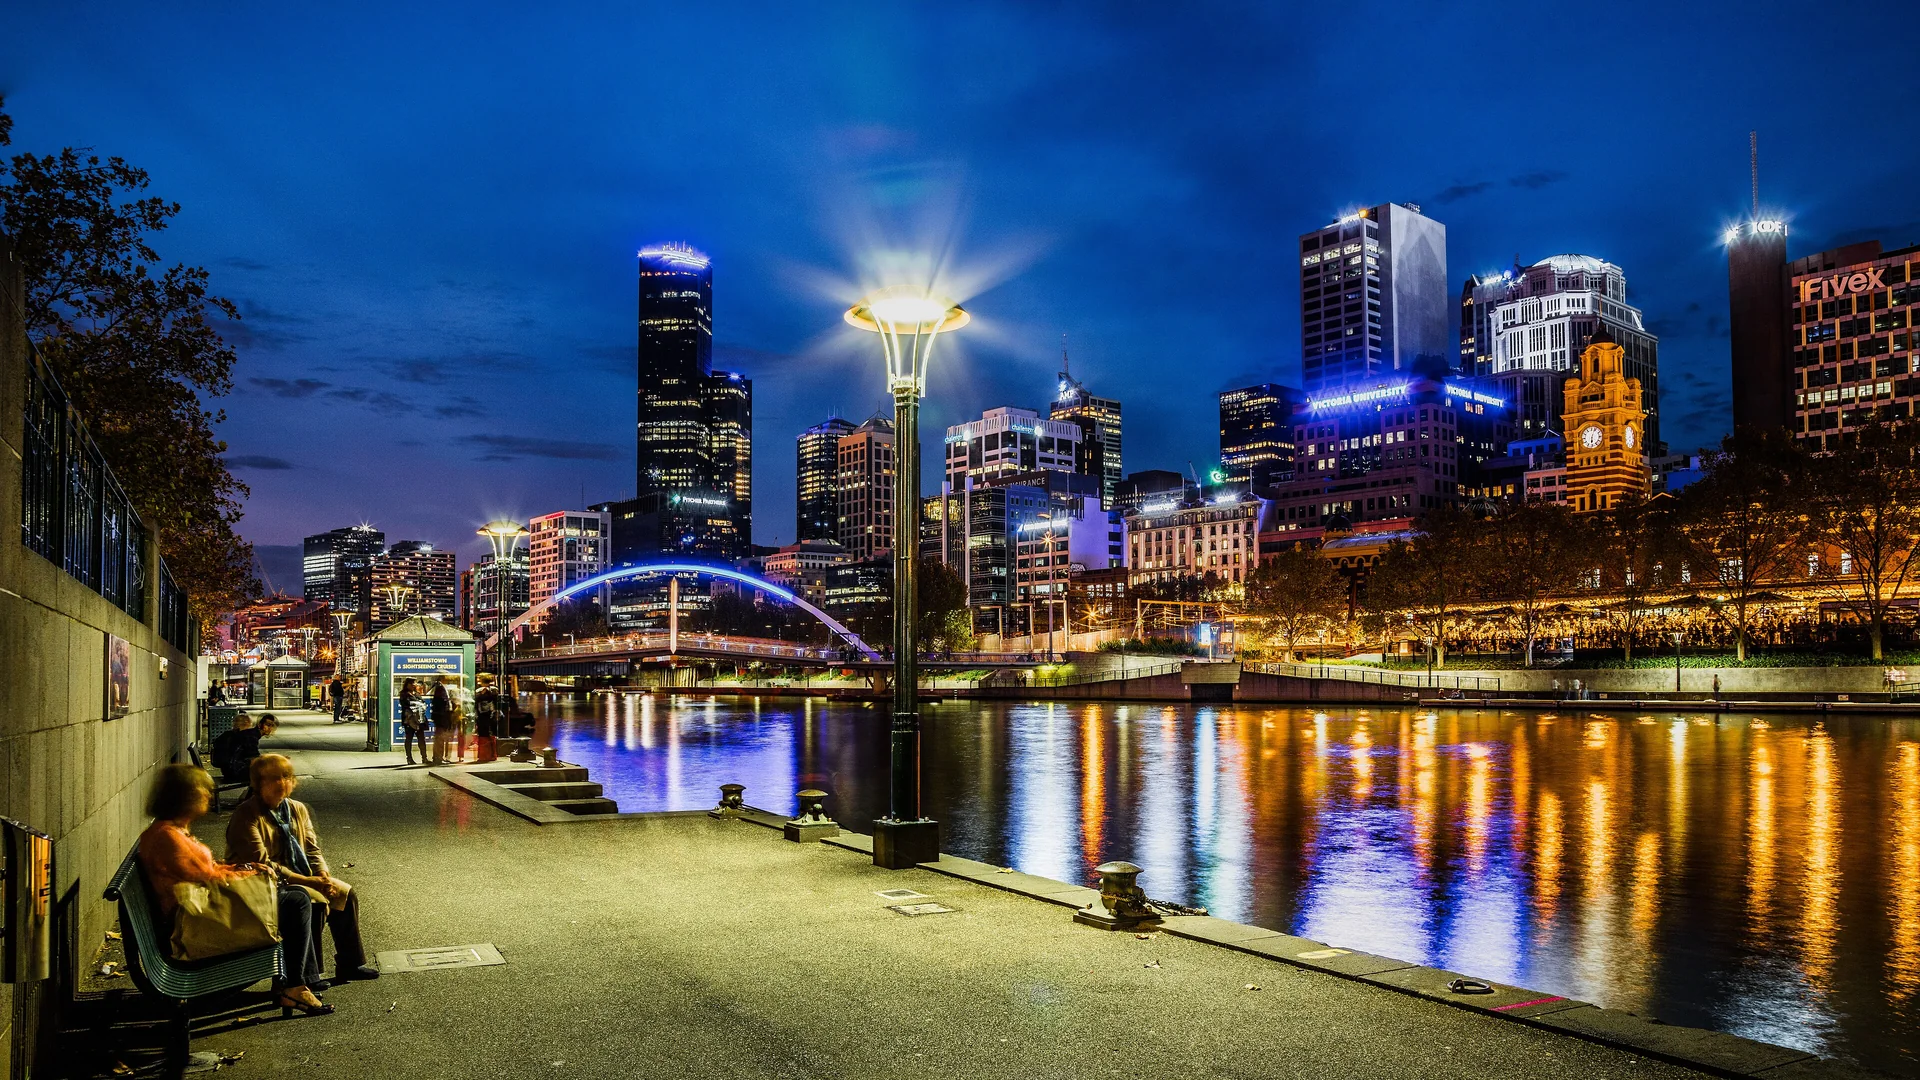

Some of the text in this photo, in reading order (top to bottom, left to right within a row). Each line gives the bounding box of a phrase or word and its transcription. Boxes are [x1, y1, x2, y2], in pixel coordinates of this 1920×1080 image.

[1312, 385, 1407, 411] VICTORIA UNIVERSITY
[1446, 384, 1504, 408] VICTORIA UNIVERSITY
